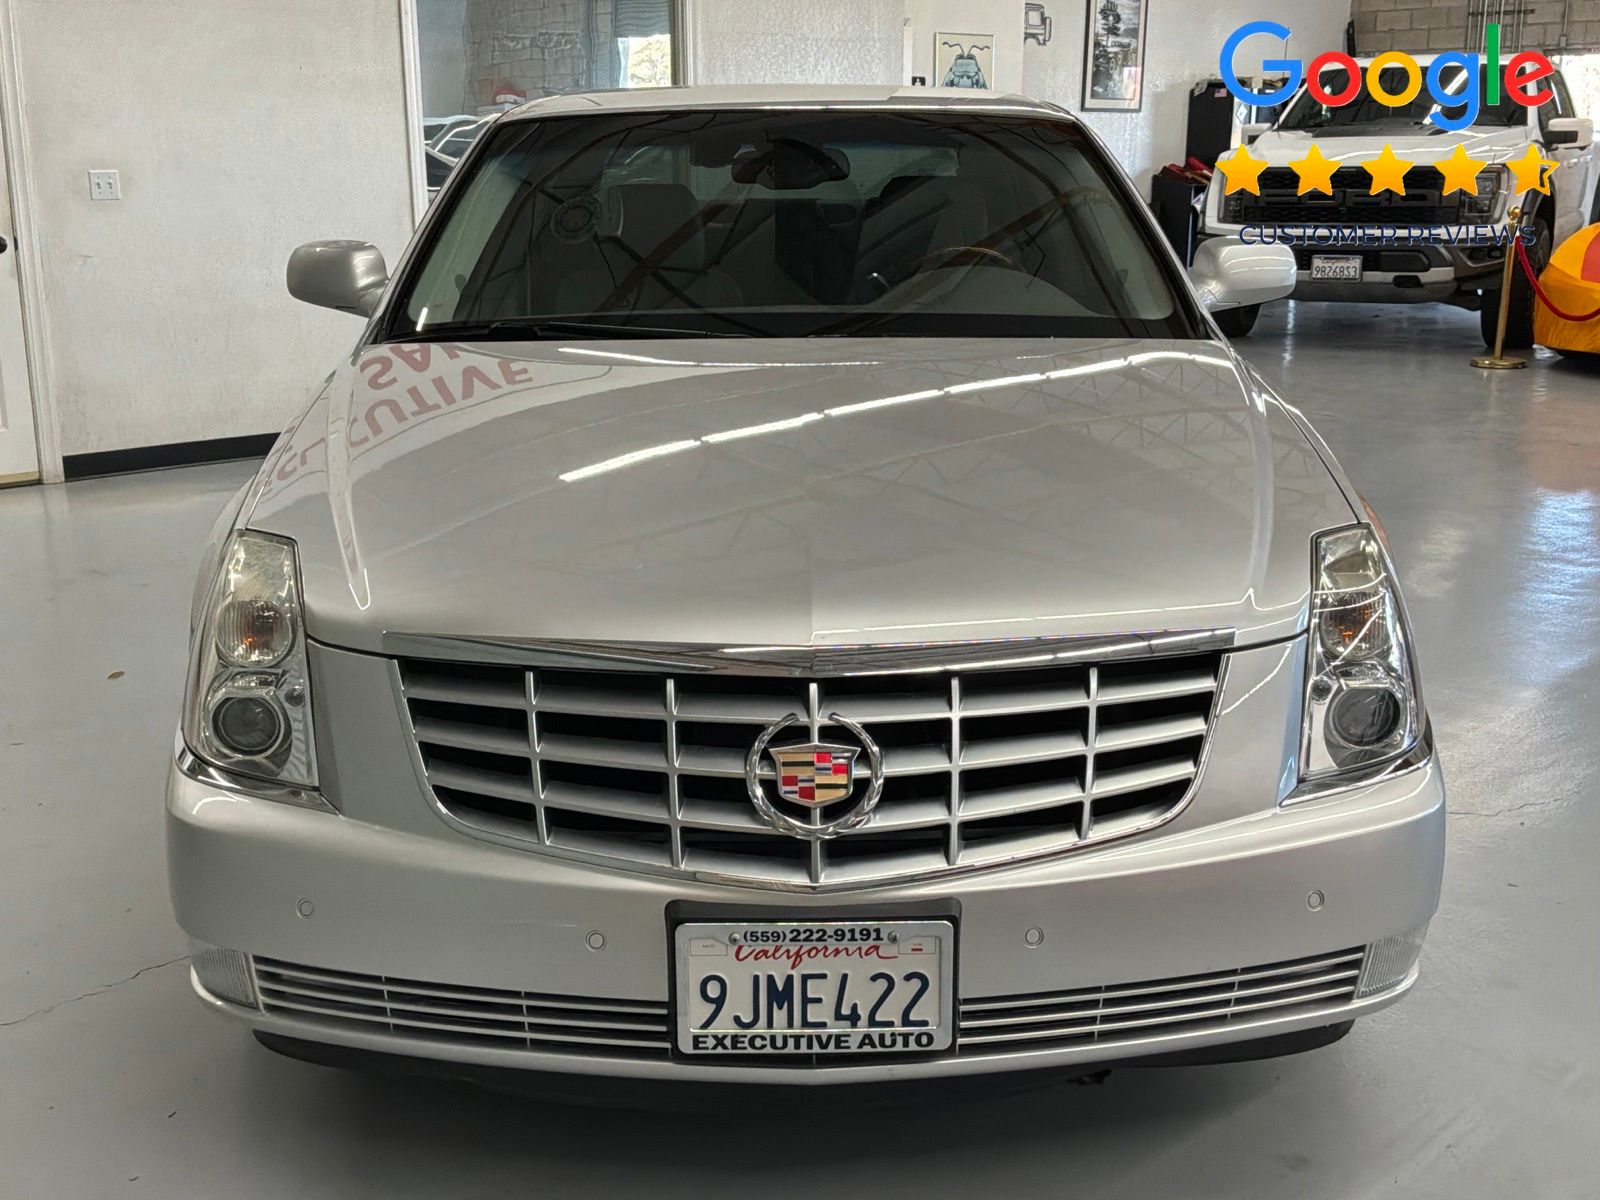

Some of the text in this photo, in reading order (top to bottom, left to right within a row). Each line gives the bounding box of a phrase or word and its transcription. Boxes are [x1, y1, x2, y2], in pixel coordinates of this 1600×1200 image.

[743, 927, 884, 943] (559) 222-9191
[735, 944, 899, 970] California
[699, 971, 930, 1029] 9JME422
[692, 1031, 935, 1051] EXECUTIVE AUTO
